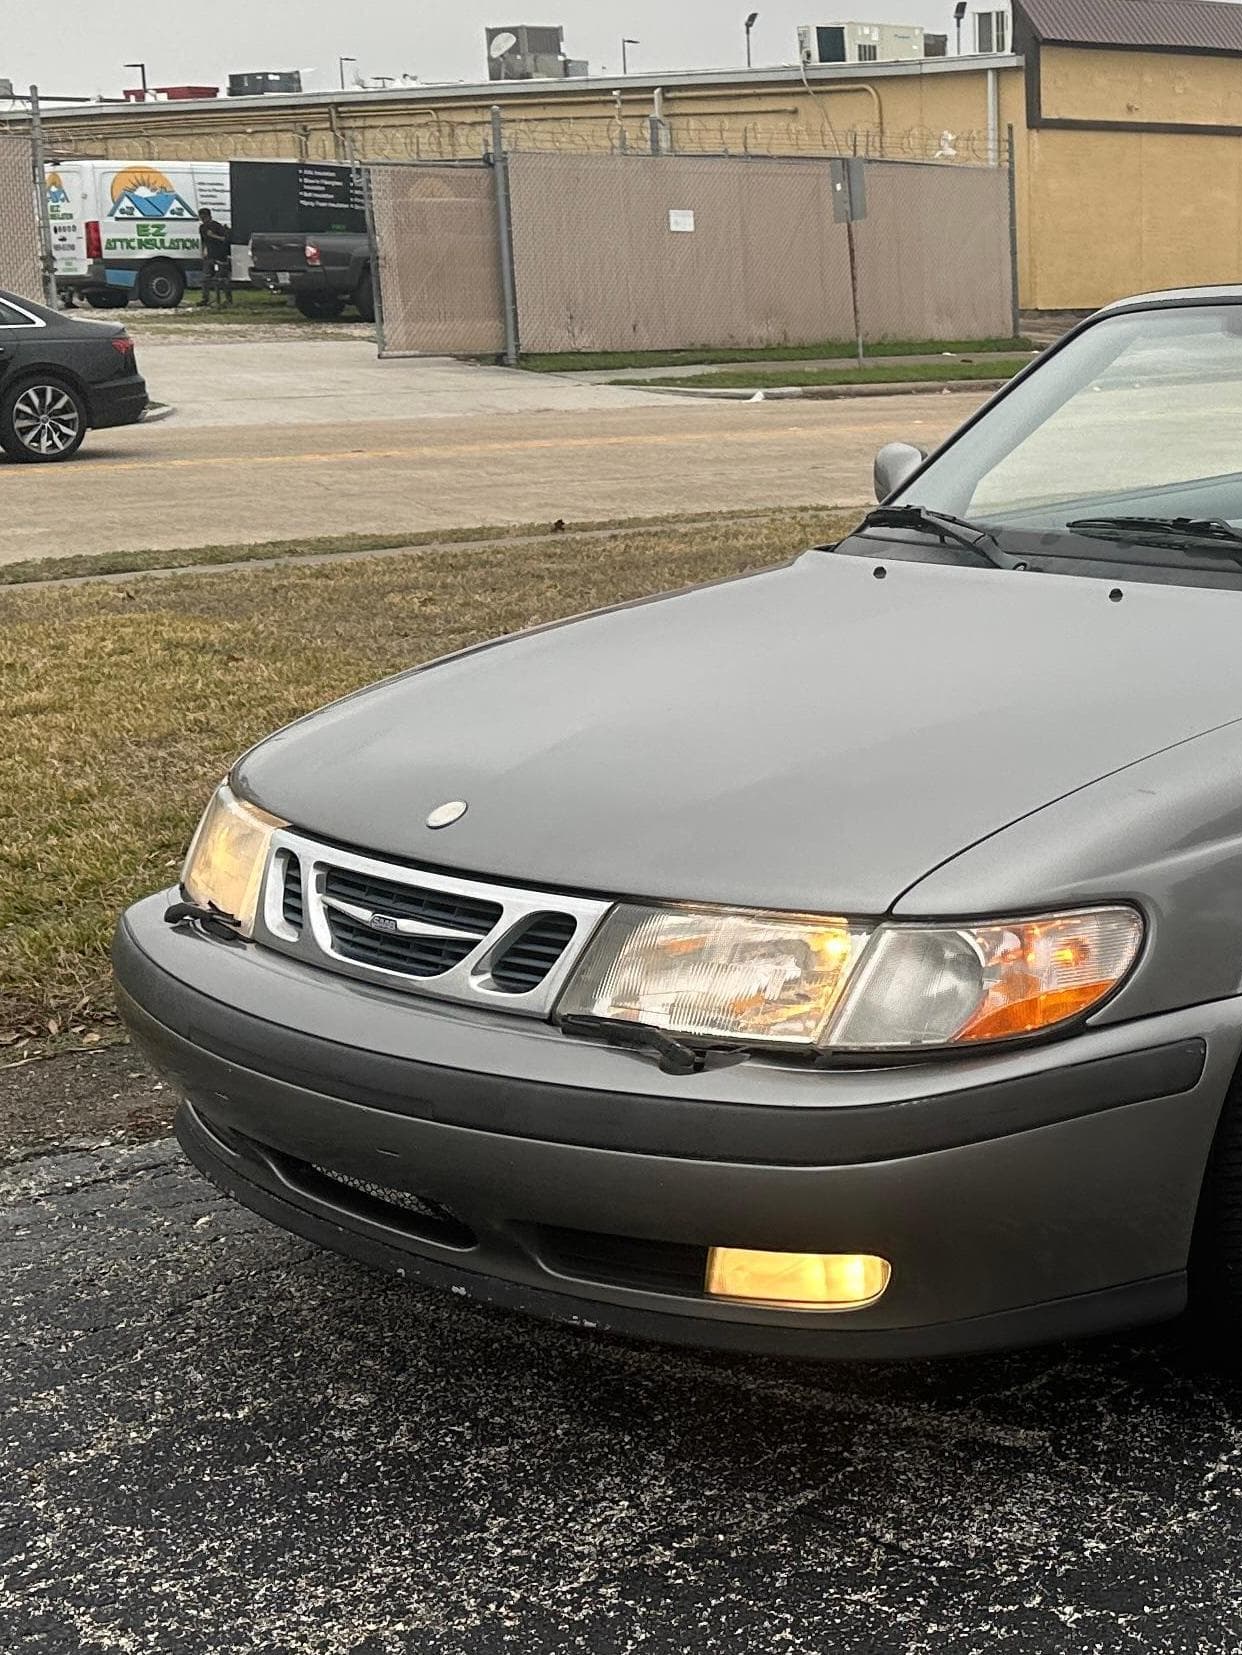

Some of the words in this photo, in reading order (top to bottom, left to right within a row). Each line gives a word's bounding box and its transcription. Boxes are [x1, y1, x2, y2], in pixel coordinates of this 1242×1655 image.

[136, 223, 167, 237] EZ
[104, 238, 136, 250] ATTIC
[137, 238, 199, 250] INSULATION
[374, 916, 396, 930] SAAB
